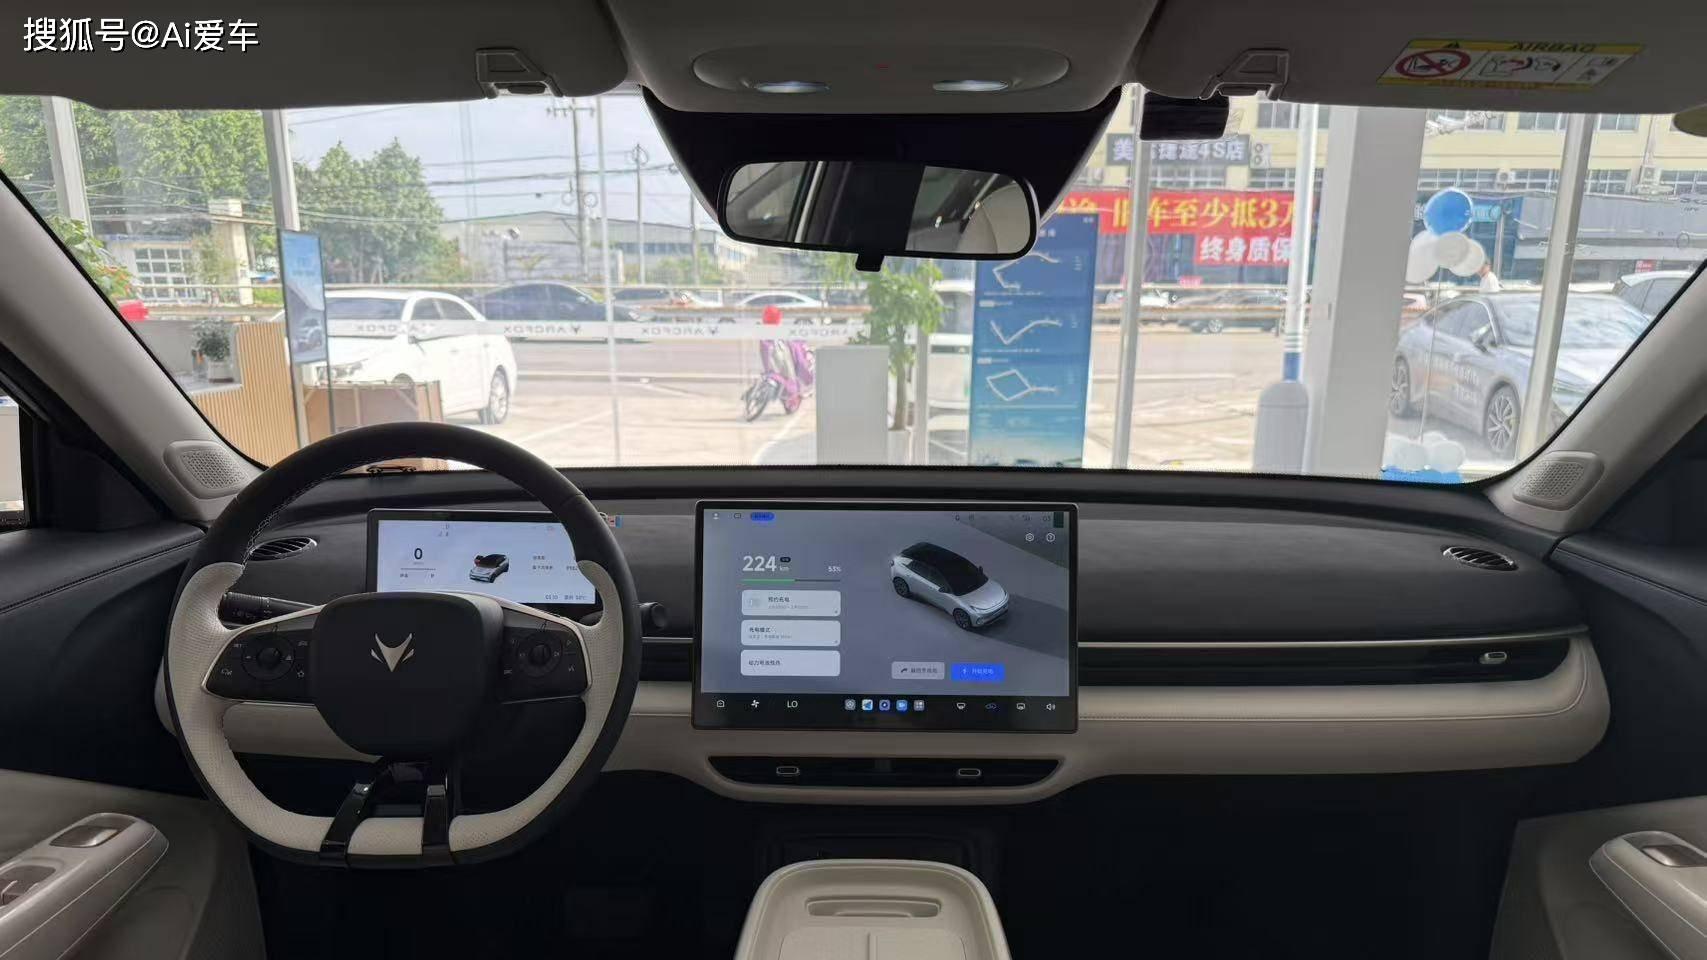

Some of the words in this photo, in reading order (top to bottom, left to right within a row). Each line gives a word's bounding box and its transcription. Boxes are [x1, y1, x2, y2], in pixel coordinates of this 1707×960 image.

[1113, 138, 1244, 161] 美捷途4S店
[414, 547, 423, 560] 0
[742, 555, 777, 572] 224
[786, 700, 799, 709] LO
